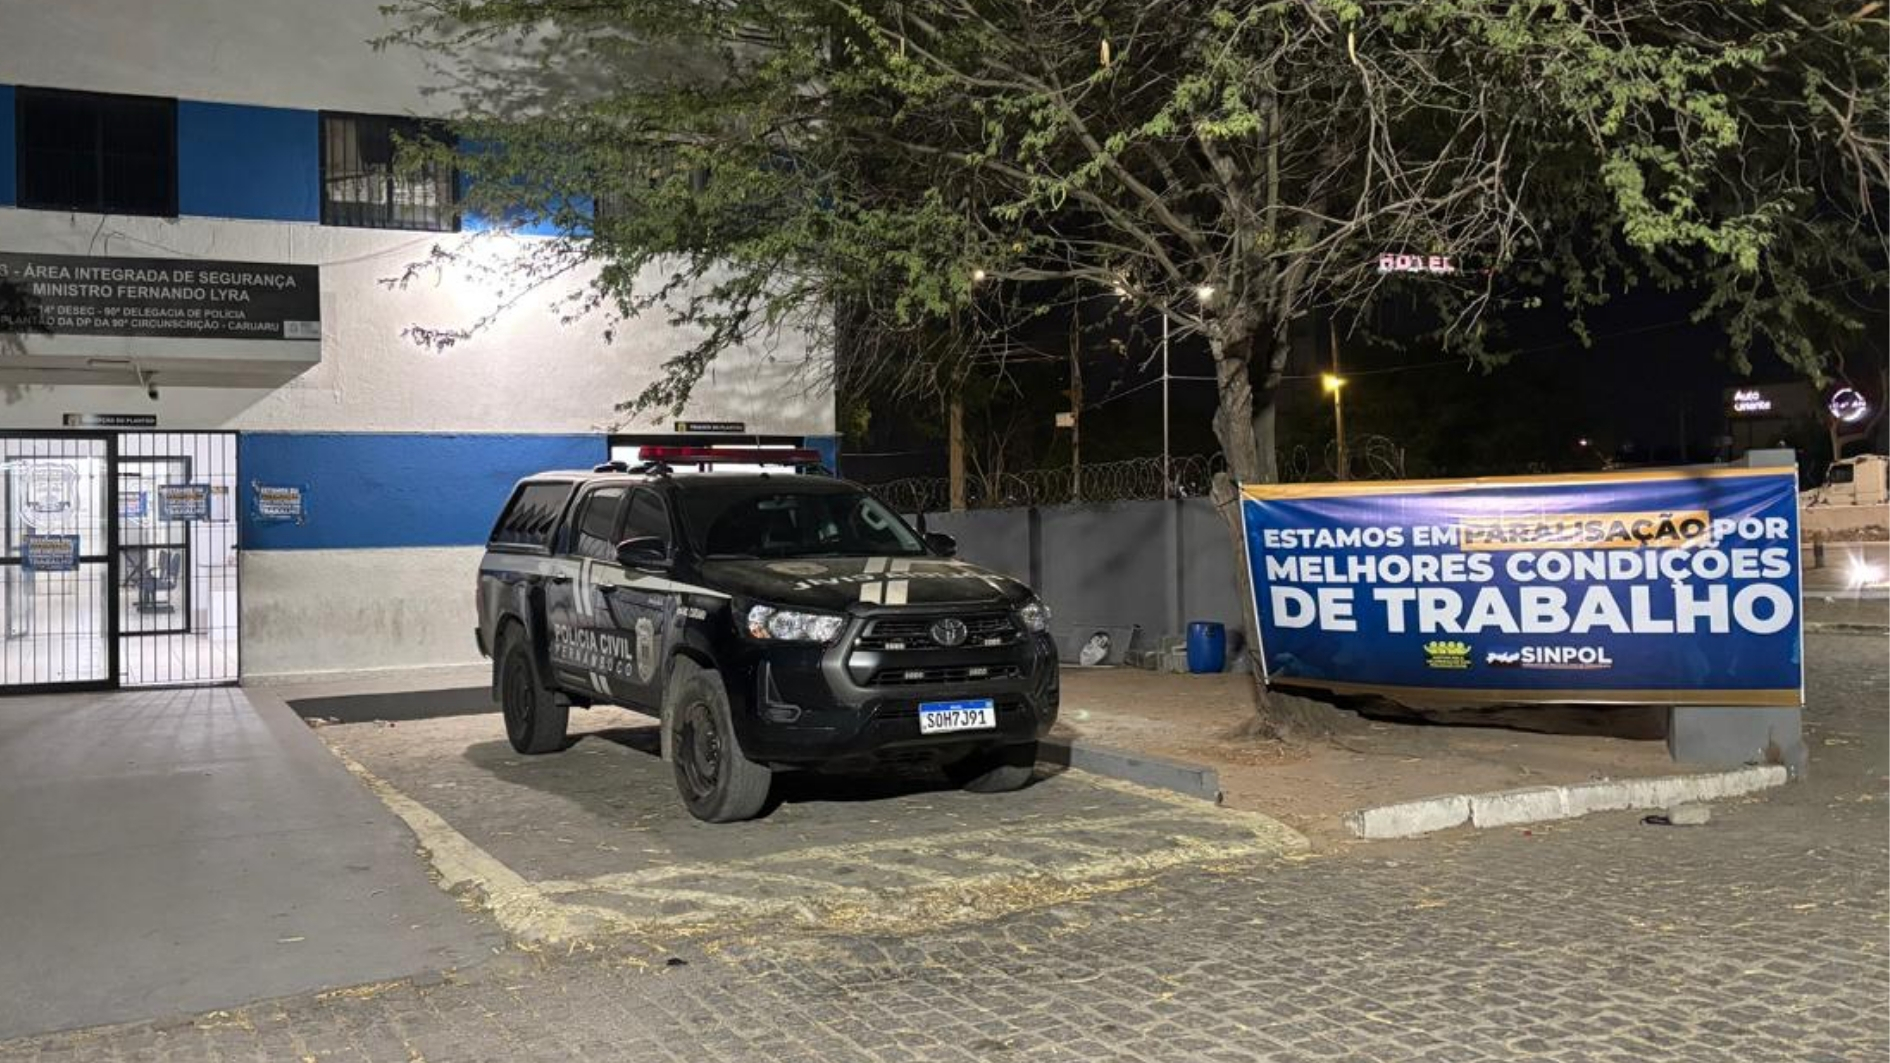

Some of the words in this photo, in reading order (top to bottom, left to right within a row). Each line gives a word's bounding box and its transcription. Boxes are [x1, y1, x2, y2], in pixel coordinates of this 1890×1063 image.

[23, 262, 71, 279] ÁREA
[74, 267, 169, 283] INTEGRADA
[173, 270, 195, 283] DE
[199, 272, 297, 289] SEGURANÇA
[33, 283, 112, 298] MINISTRO
[117, 286, 206, 300] FERNANDO
[210, 289, 250, 302] LYRA
[57, 305, 95, 315] DESEC
[123, 307, 185, 318] DELEGACIA
[187, 309, 200, 318] DE
[205, 308, 246, 319] POLÍCIA
[57, 317, 73, 327] DA
[76, 317, 91, 327] DP
[93, 318, 110, 328] DA
[228, 321, 279, 331] CARUARU
[1263, 526, 1405, 549] ESTAMOS
[1412, 524, 1459, 547] EM
[1712, 516, 1790, 541] POR
[1265, 552, 1496, 583] MELHORES
[1505, 540, 1791, 589] CONDIÇÕES
[1270, 585, 1358, 632] DE
[1373, 582, 1794, 635] TRABALHO
[600, 634, 633, 660] CIVIL
[1521, 646, 1613, 664] SINPOL
[926, 709, 987, 729] SOH7J91
